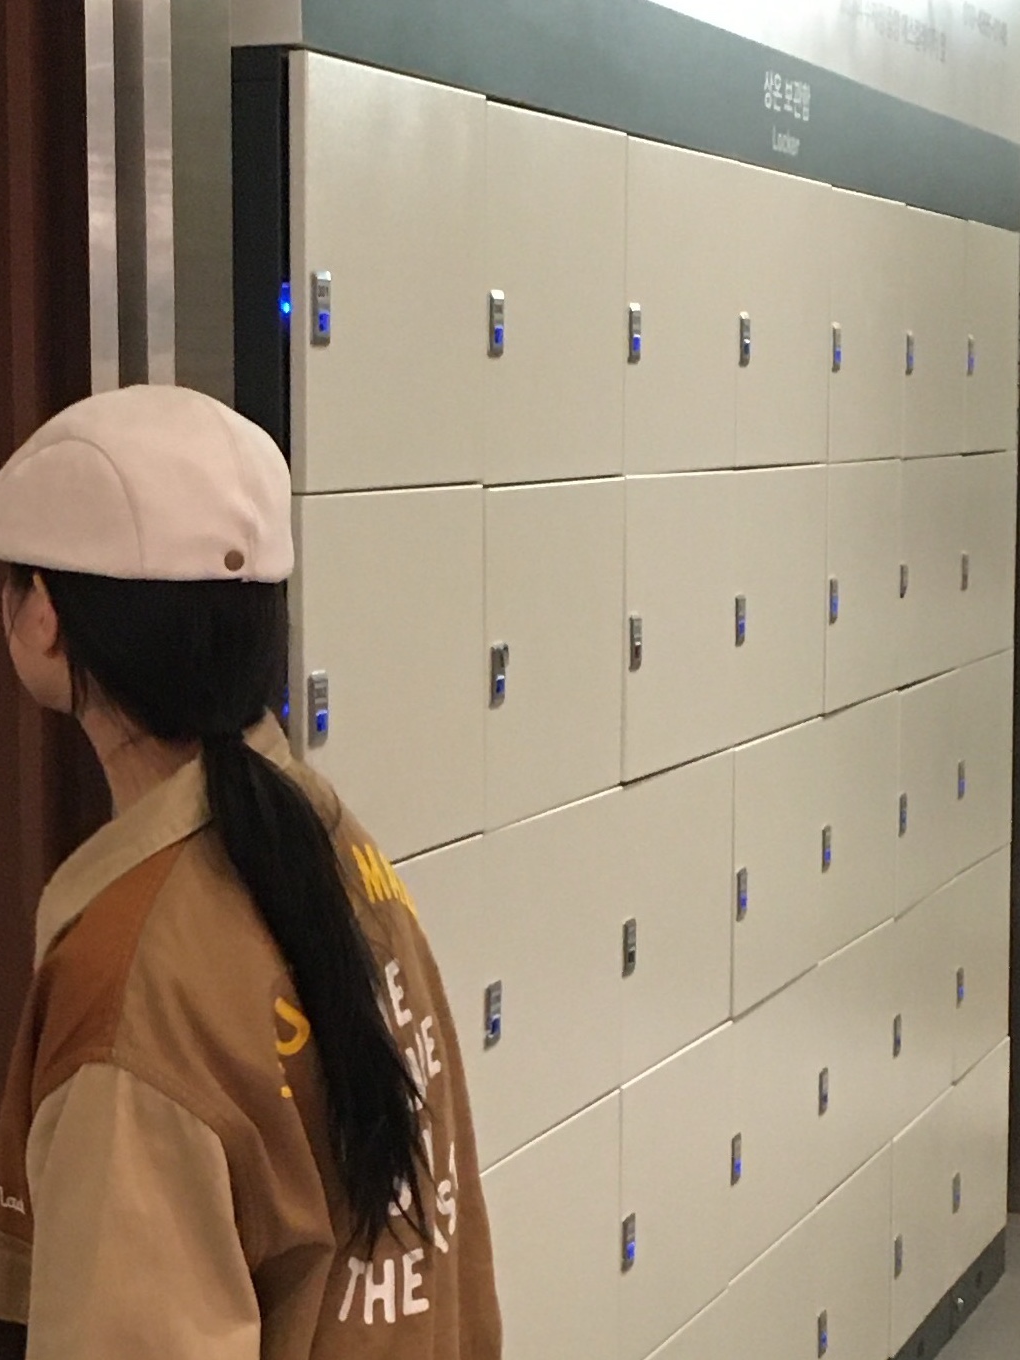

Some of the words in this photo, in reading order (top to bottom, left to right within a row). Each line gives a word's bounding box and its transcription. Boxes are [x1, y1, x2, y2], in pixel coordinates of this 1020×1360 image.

[764, 71, 782, 111] 상온
[784, 80, 811, 121] 보관함
[338, 1248, 429, 1325] THE
